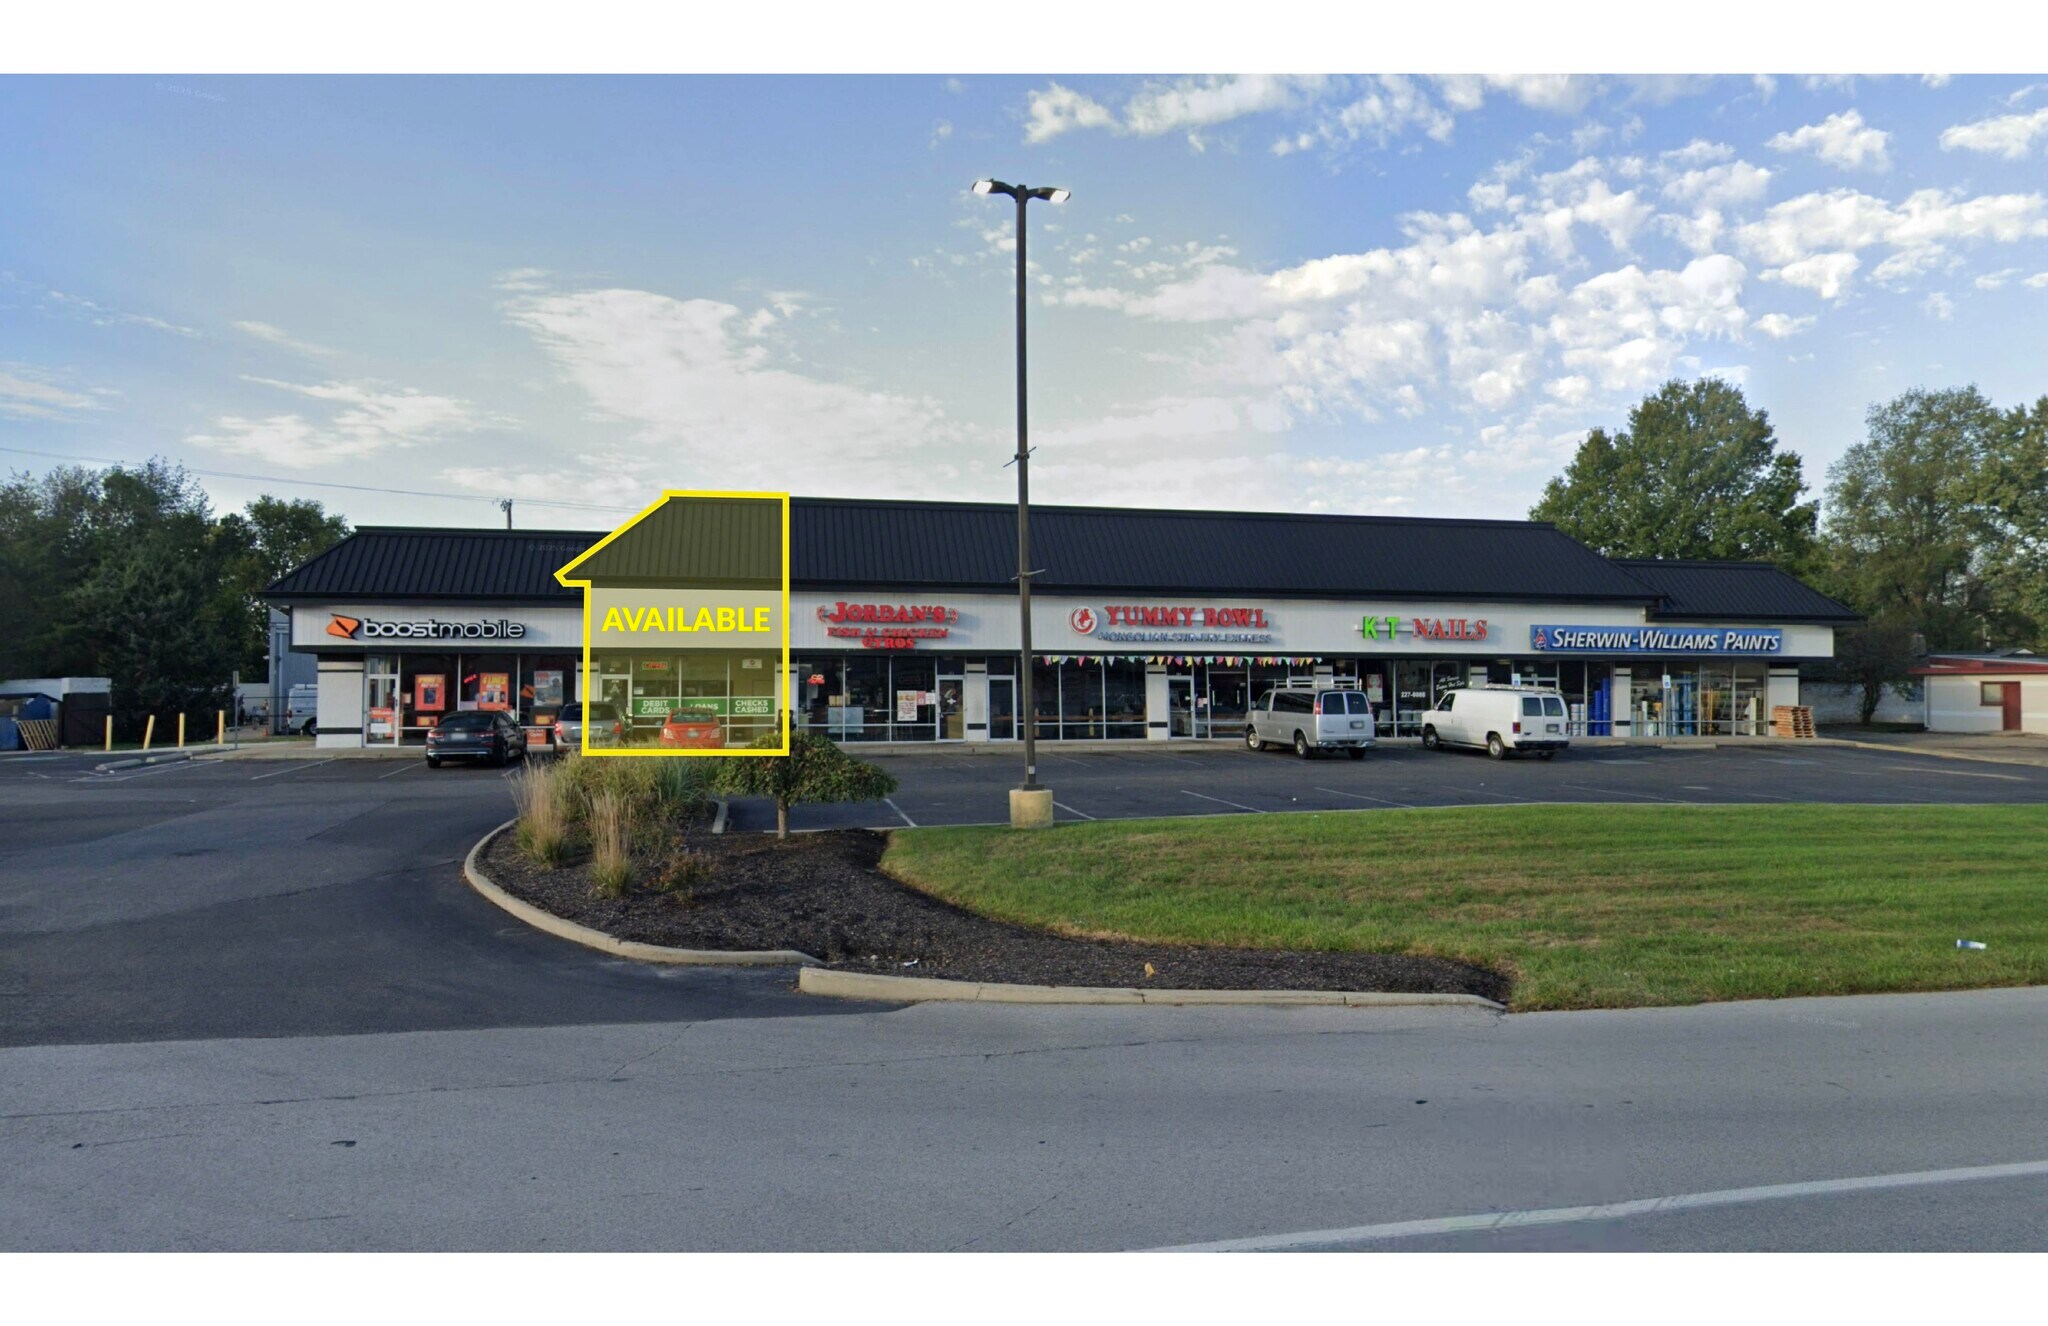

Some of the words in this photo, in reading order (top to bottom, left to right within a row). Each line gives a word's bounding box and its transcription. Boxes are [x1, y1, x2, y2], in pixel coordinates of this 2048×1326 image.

[828, 602, 946, 624] JORDAN'S
[1105, 605, 1196, 628] YUMMY
[1203, 608, 1269, 629] BOWL
[827, 626, 862, 638] FISH
[865, 627, 877, 638] &
[880, 627, 949, 639] CHICKEN
[1098, 631, 1168, 642] MONGOLIAN
[1224, 633, 1272, 643] EXPRESS
[1413, 618, 1488, 640] NAILS
[1552, 628, 1719, 650] SHERWIN-WILLIAMS
[1723, 631, 1780, 650] PAINTS
[861, 637, 915, 649] GYROS
